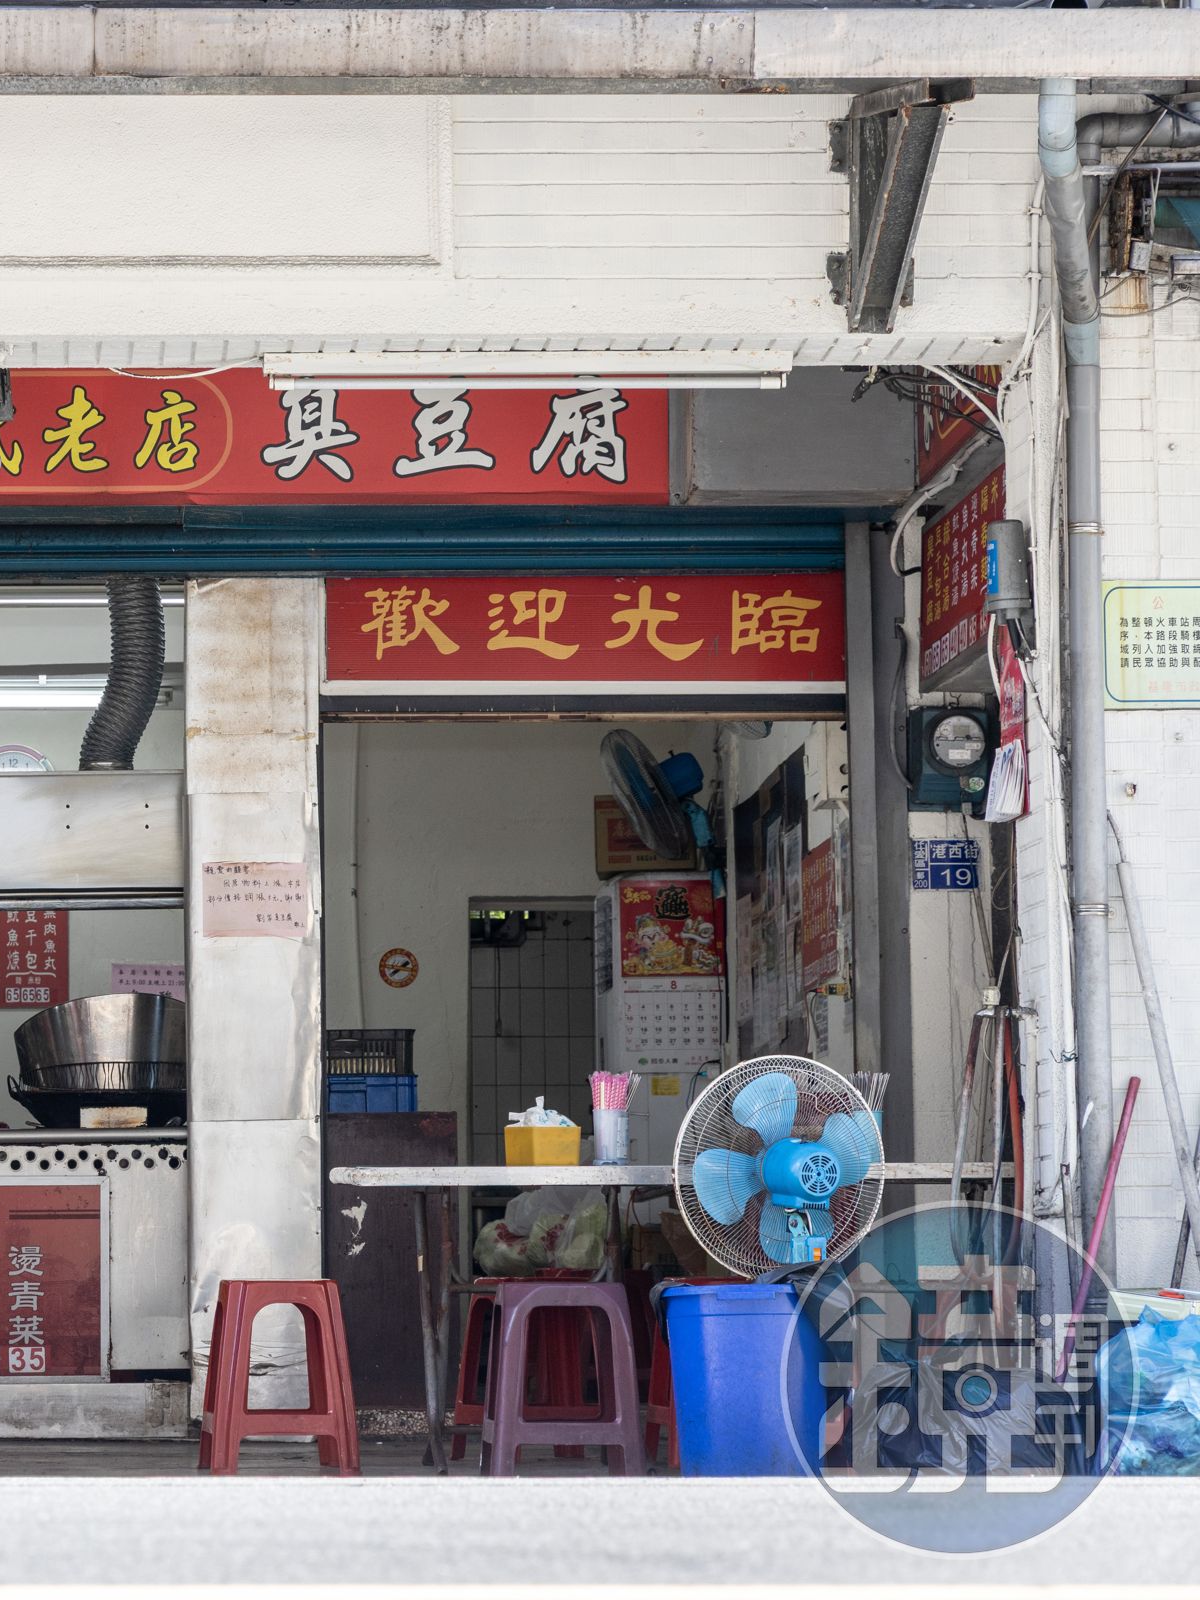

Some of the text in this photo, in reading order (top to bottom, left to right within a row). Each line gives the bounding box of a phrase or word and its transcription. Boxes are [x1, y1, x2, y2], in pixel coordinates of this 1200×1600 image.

[261, 385, 628, 484] 臭豆腐
[361, 585, 822, 661] 歡迎光臨
[931, 843, 979, 859] 港西街
[940, 868, 972, 886] 19
[6, 987, 20, 1001] 65
[22, 987, 35, 1001] 65
[36, 987, 50, 1001] 65
[671, 980, 677, 989] 8
[8, 1246, 45, 1346] 燙青菜
[10, 1348, 45, 1373] 35
